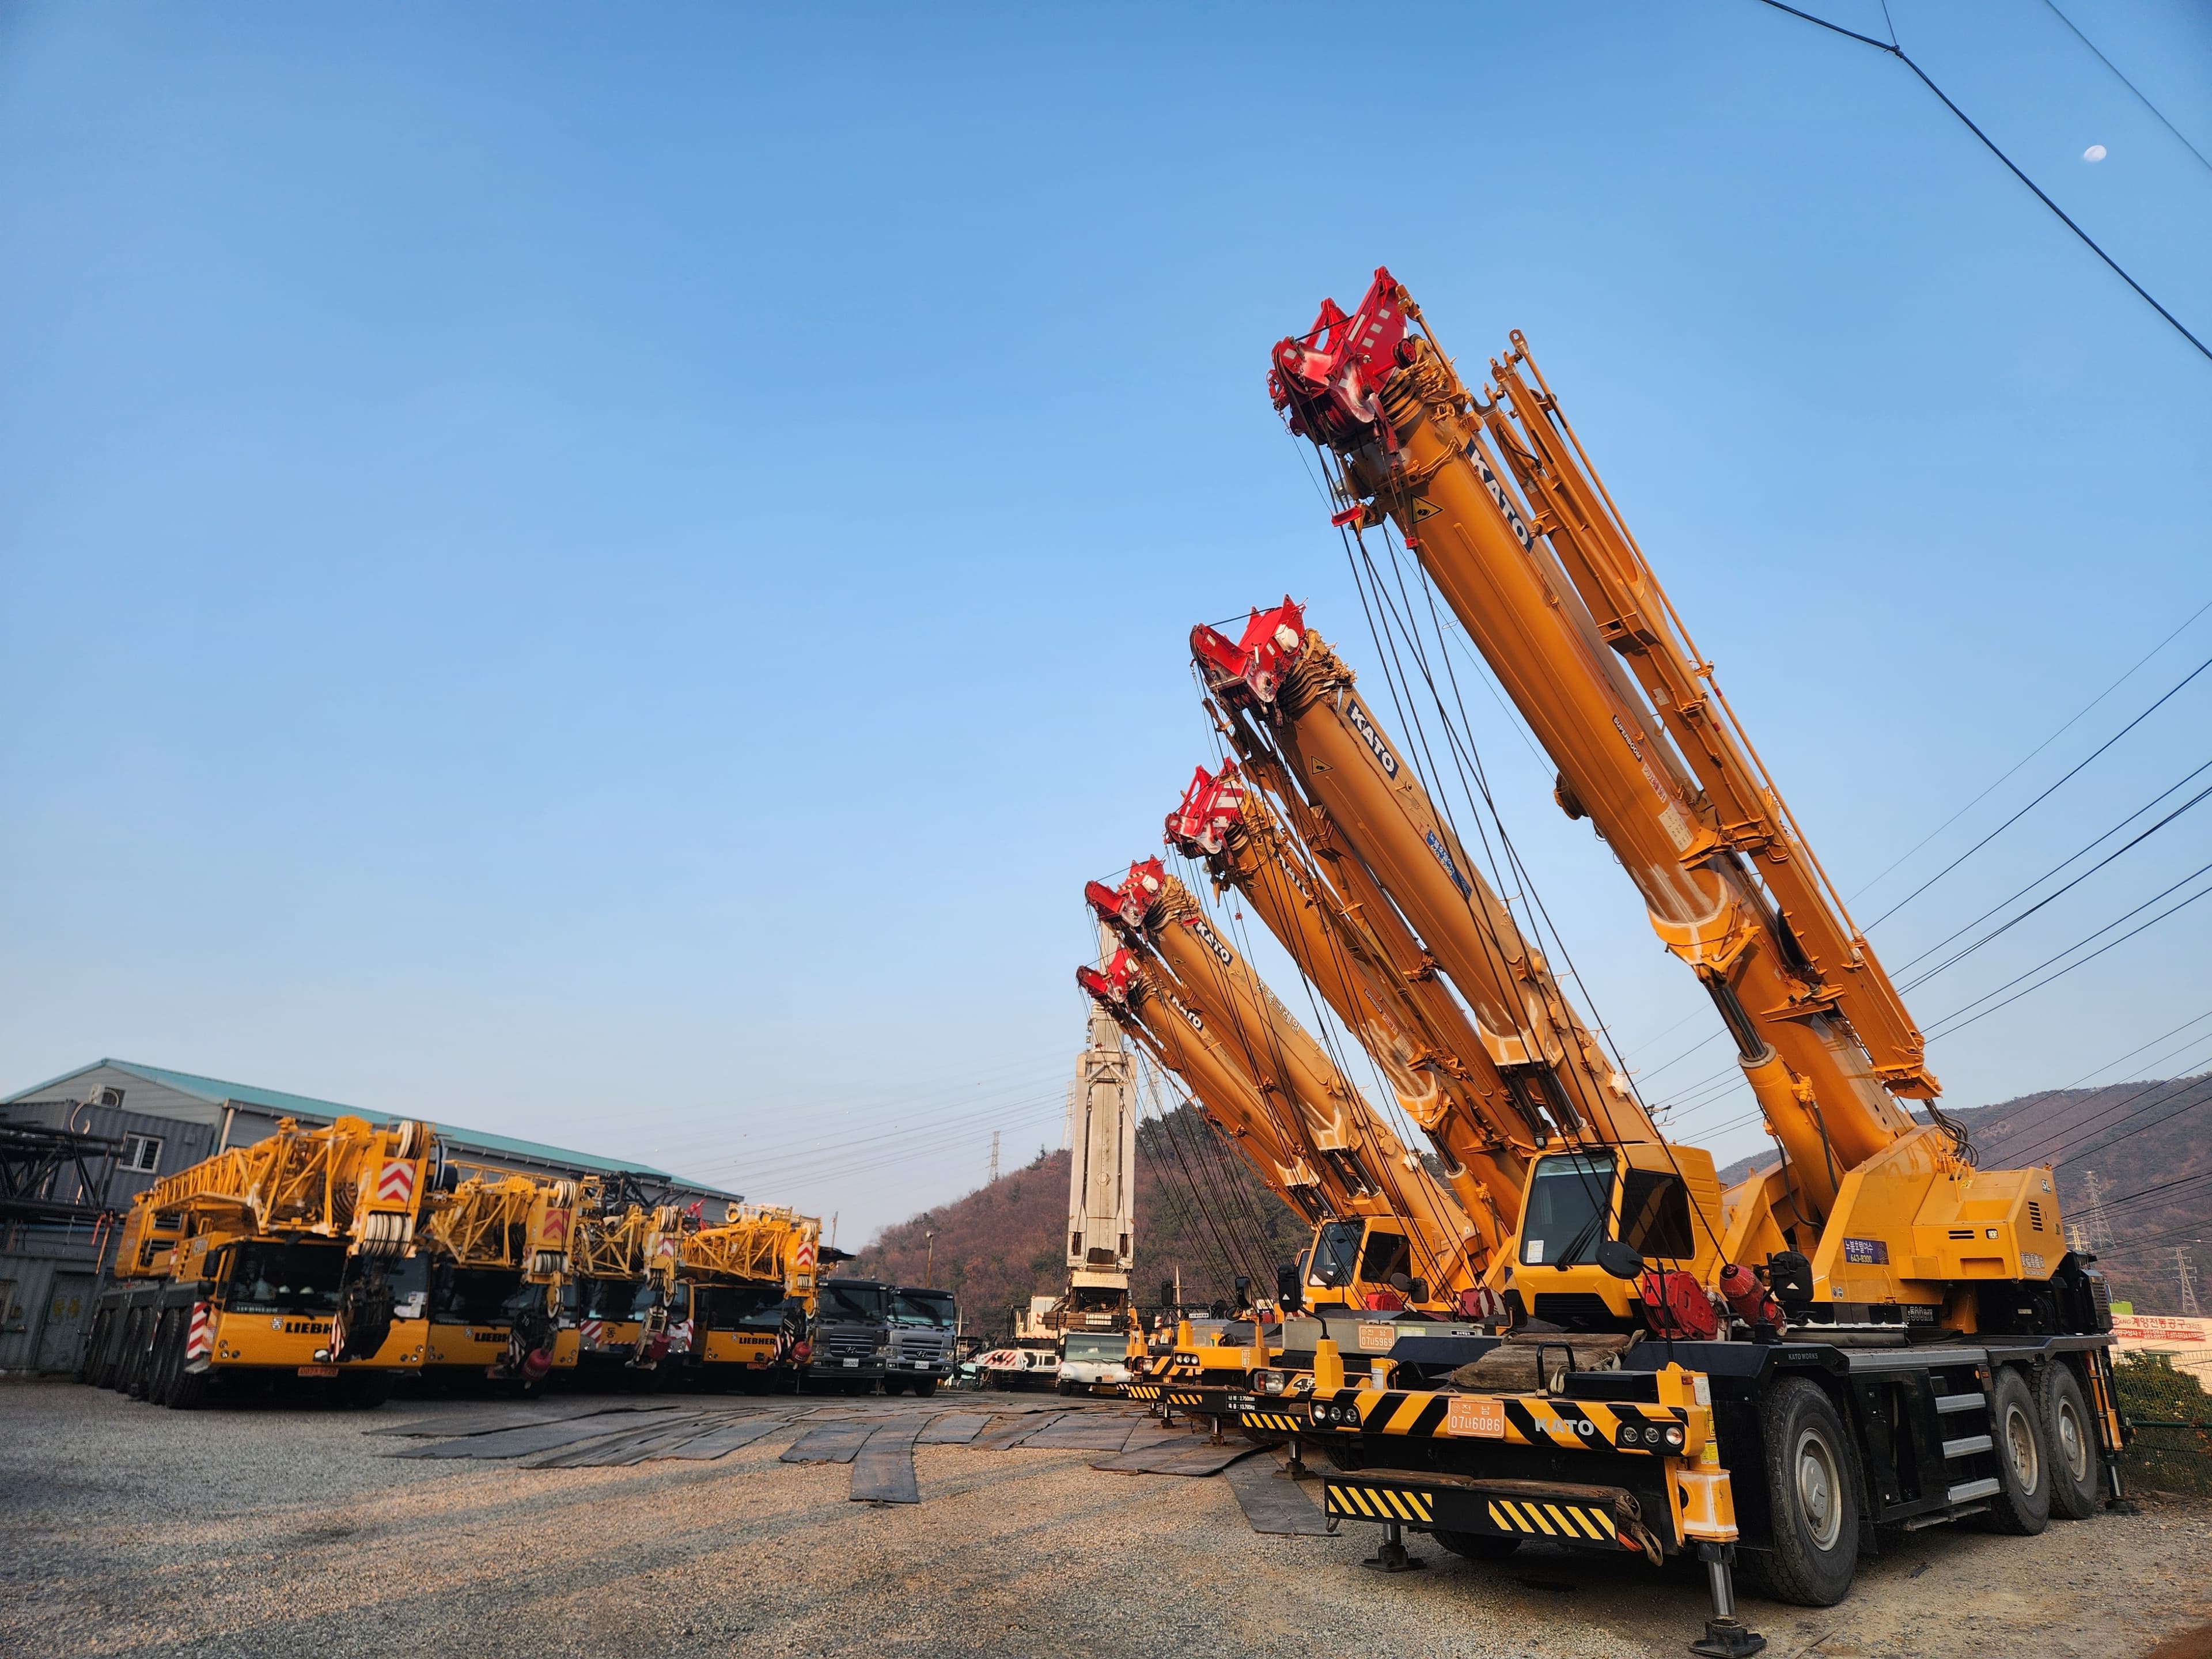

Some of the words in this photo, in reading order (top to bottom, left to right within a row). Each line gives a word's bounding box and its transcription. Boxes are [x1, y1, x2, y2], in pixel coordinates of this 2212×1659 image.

[1470, 449, 1528, 546] KATO
[1351, 706, 1394, 772] KATO
[1613, 716, 1642, 760] SUPERBOOM
[1196, 921, 1230, 962] KATO
[1845, 1240, 1874, 1253] 노블호텔여수
[1850, 1253, 1873, 1263] 643-8300
[285, 1321, 333, 1334] LIEBH
[2131, 1317, 2186, 1330] 계양전동공구
[739, 1337, 776, 1345] LIEBHER
[1361, 1336, 1393, 1346] 07나5969
[1451, 1415, 1501, 1432] 07나6086
[1534, 1417, 1594, 1436] KATO
